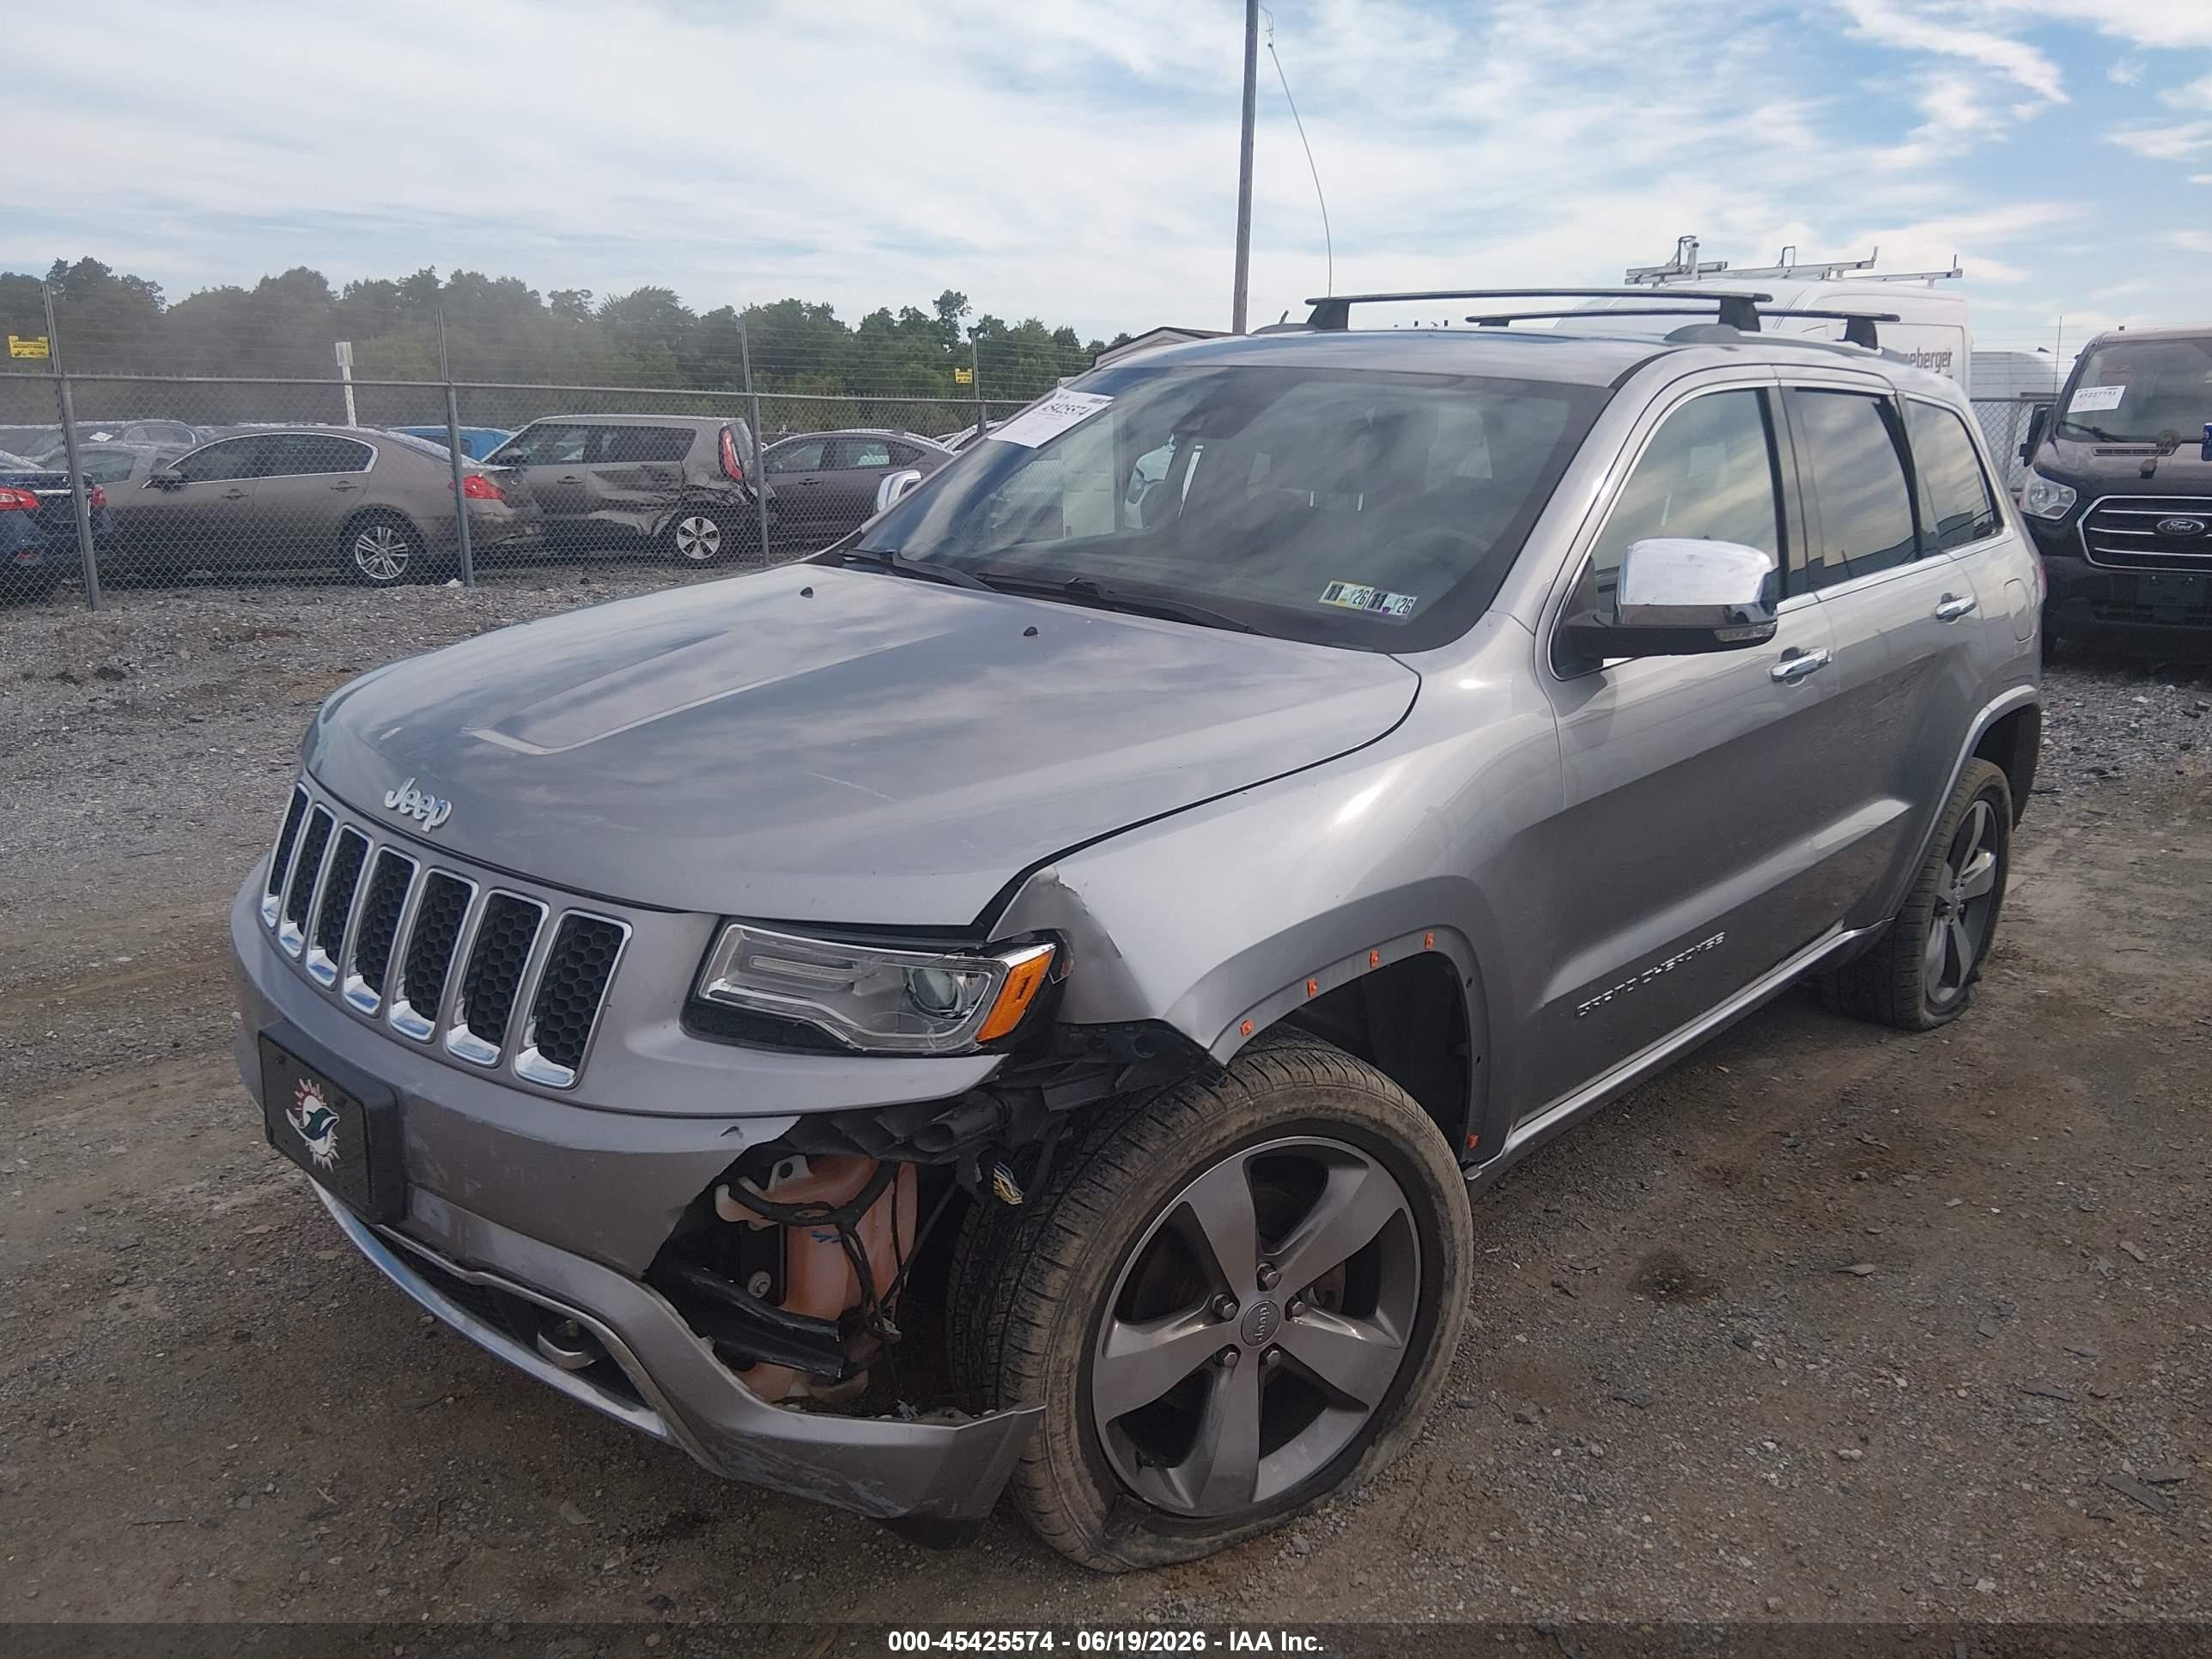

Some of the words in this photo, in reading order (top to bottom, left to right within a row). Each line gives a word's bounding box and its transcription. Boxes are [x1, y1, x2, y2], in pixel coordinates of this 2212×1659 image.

[2166, 520, 2193, 531] Ford
[1352, 589, 1370, 605] 26
[1396, 598, 1413, 614] 26
[384, 776, 453, 833] Jeep
